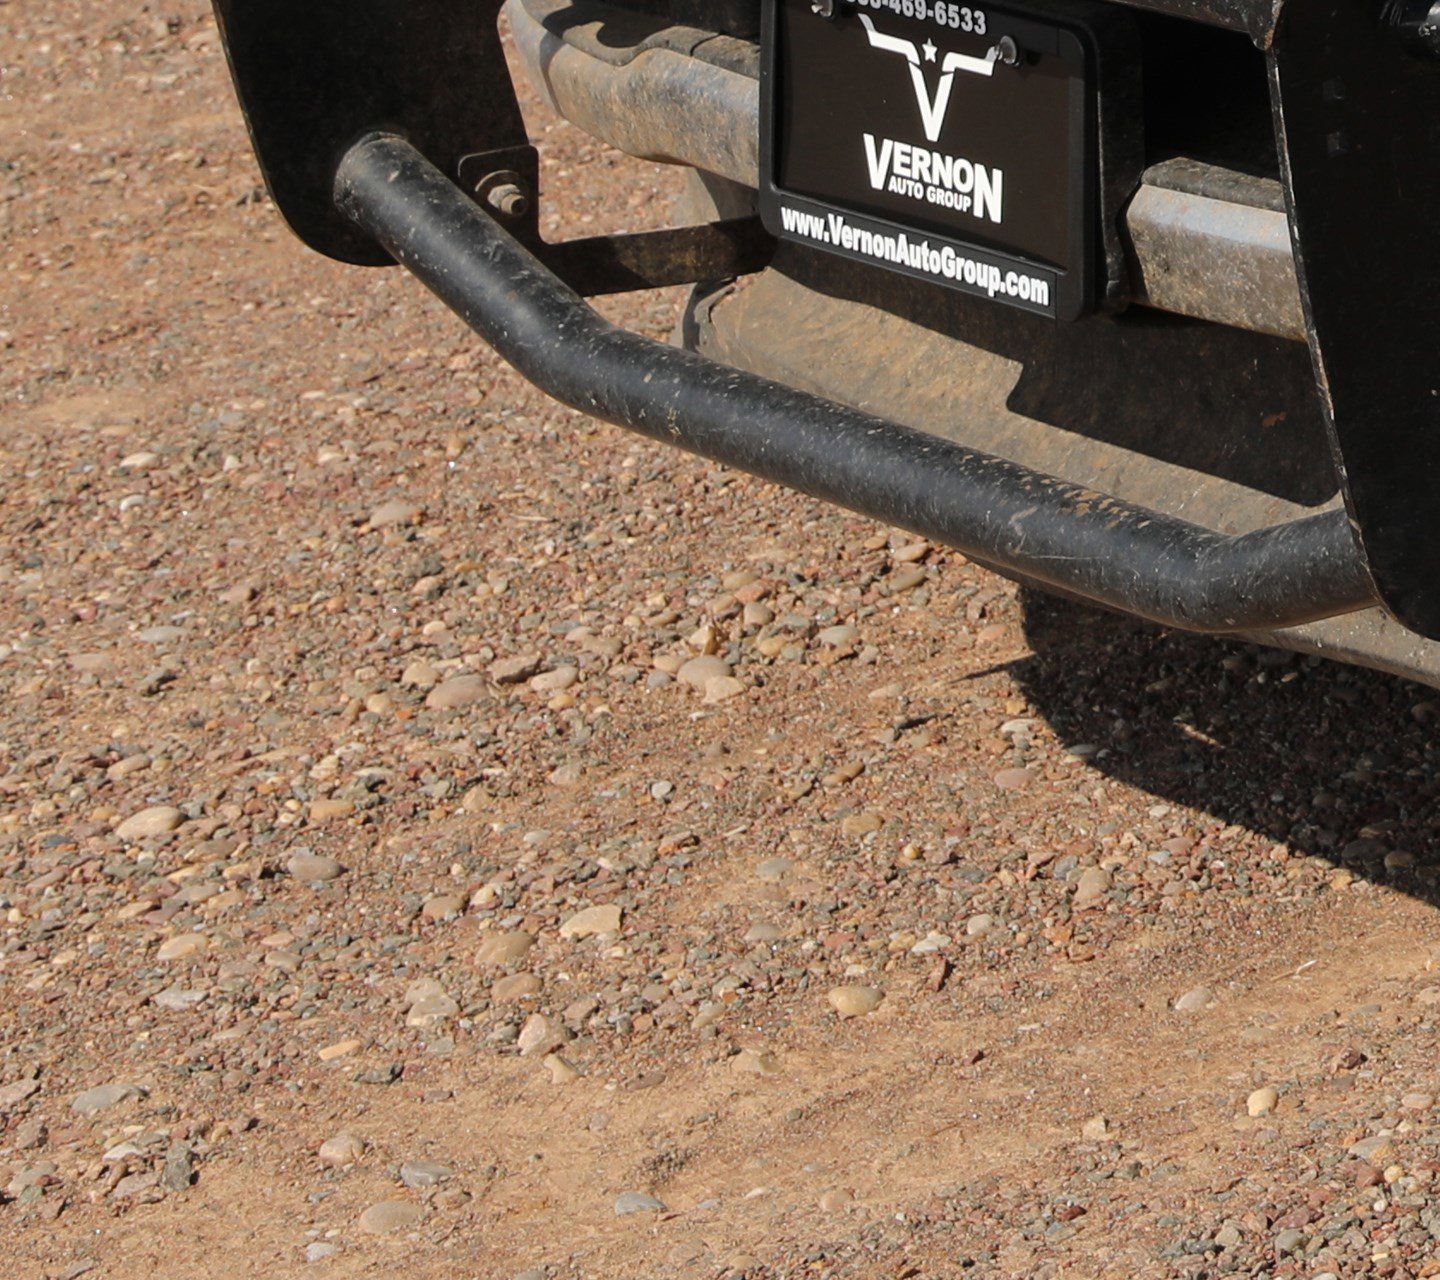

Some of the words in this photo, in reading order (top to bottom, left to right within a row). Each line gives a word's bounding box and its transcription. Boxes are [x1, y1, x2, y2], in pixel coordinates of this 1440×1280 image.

[863, 132, 1003, 224] VERNON
[888, 176, 924, 201] AUTO
[926, 187, 972, 213] GROUP
[780, 206, 1049, 306] www.VernonAutoGroup.com
